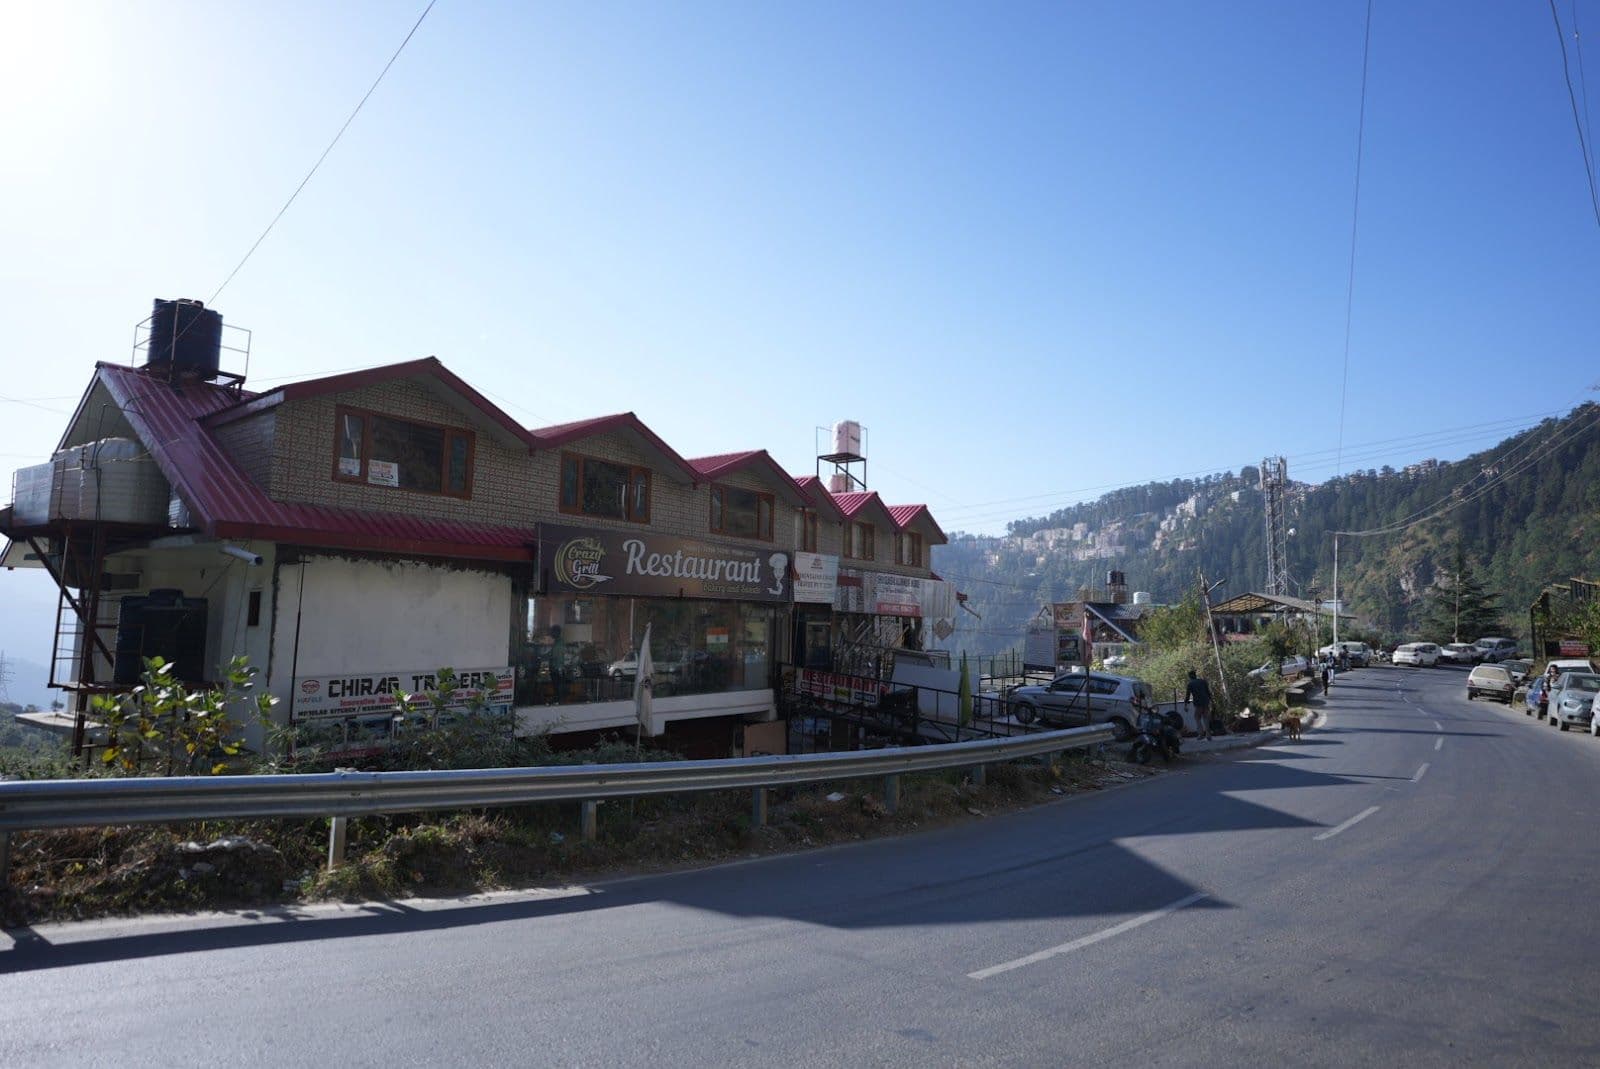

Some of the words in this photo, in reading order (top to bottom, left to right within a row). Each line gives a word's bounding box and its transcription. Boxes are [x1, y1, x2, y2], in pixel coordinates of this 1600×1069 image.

[568, 546, 602, 561] Crazy
[623, 539, 761, 584] Restaurant
[572, 560, 599, 582] Grill
[328, 677, 400, 698] CHIRAG
